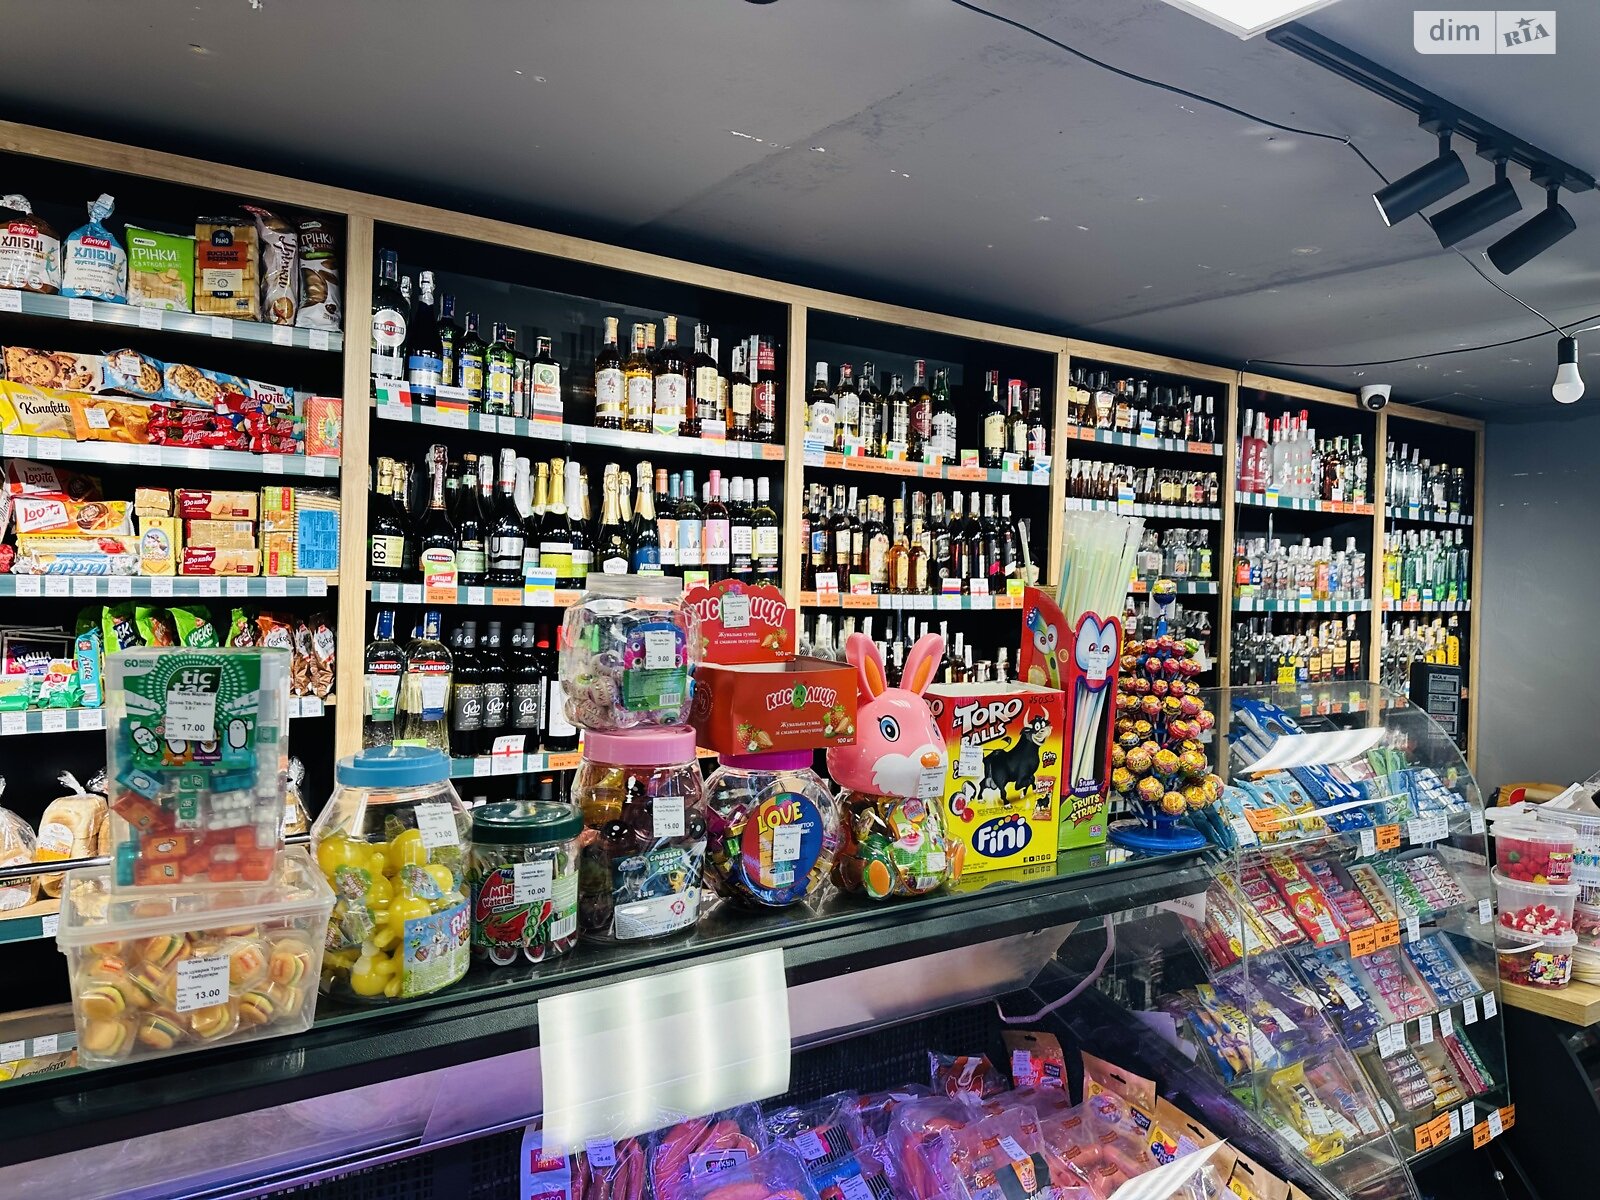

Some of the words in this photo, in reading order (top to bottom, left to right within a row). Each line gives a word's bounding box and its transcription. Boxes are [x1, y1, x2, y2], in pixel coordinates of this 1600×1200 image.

[1, 236, 43, 253] ХЛІБЦІ
[74, 247, 117, 265] ХЛІБЦІ
[131, 247, 177, 261] ГРІНКИ
[374, 322, 404, 335] MARTINI
[19, 400, 71, 416] Konafetto
[374, 537, 386, 564] 1821
[124, 659, 138, 668] 60
[368, 663, 402, 671] MARENGO
[419, 664, 450, 672] MARENGO
[181, 669, 212, 685] tic
[952, 717, 963, 728] EL
[954, 698, 1024, 735] TORO
[182, 723, 206, 732] 17.00
[961, 722, 1006, 746] BALLS
[1072, 793, 1101, 811] FRUITS
[756, 801, 803, 835] LOVE
[1070, 802, 1104, 822] STRAWS
[434, 830, 452, 839] 13.00
[978, 817, 1026, 854] Fini
[784, 847, 795, 855] 5.00
[490, 883, 514, 898] MIN
[527, 887, 546, 896] 10.00
[195, 988, 220, 1000] 13.00
